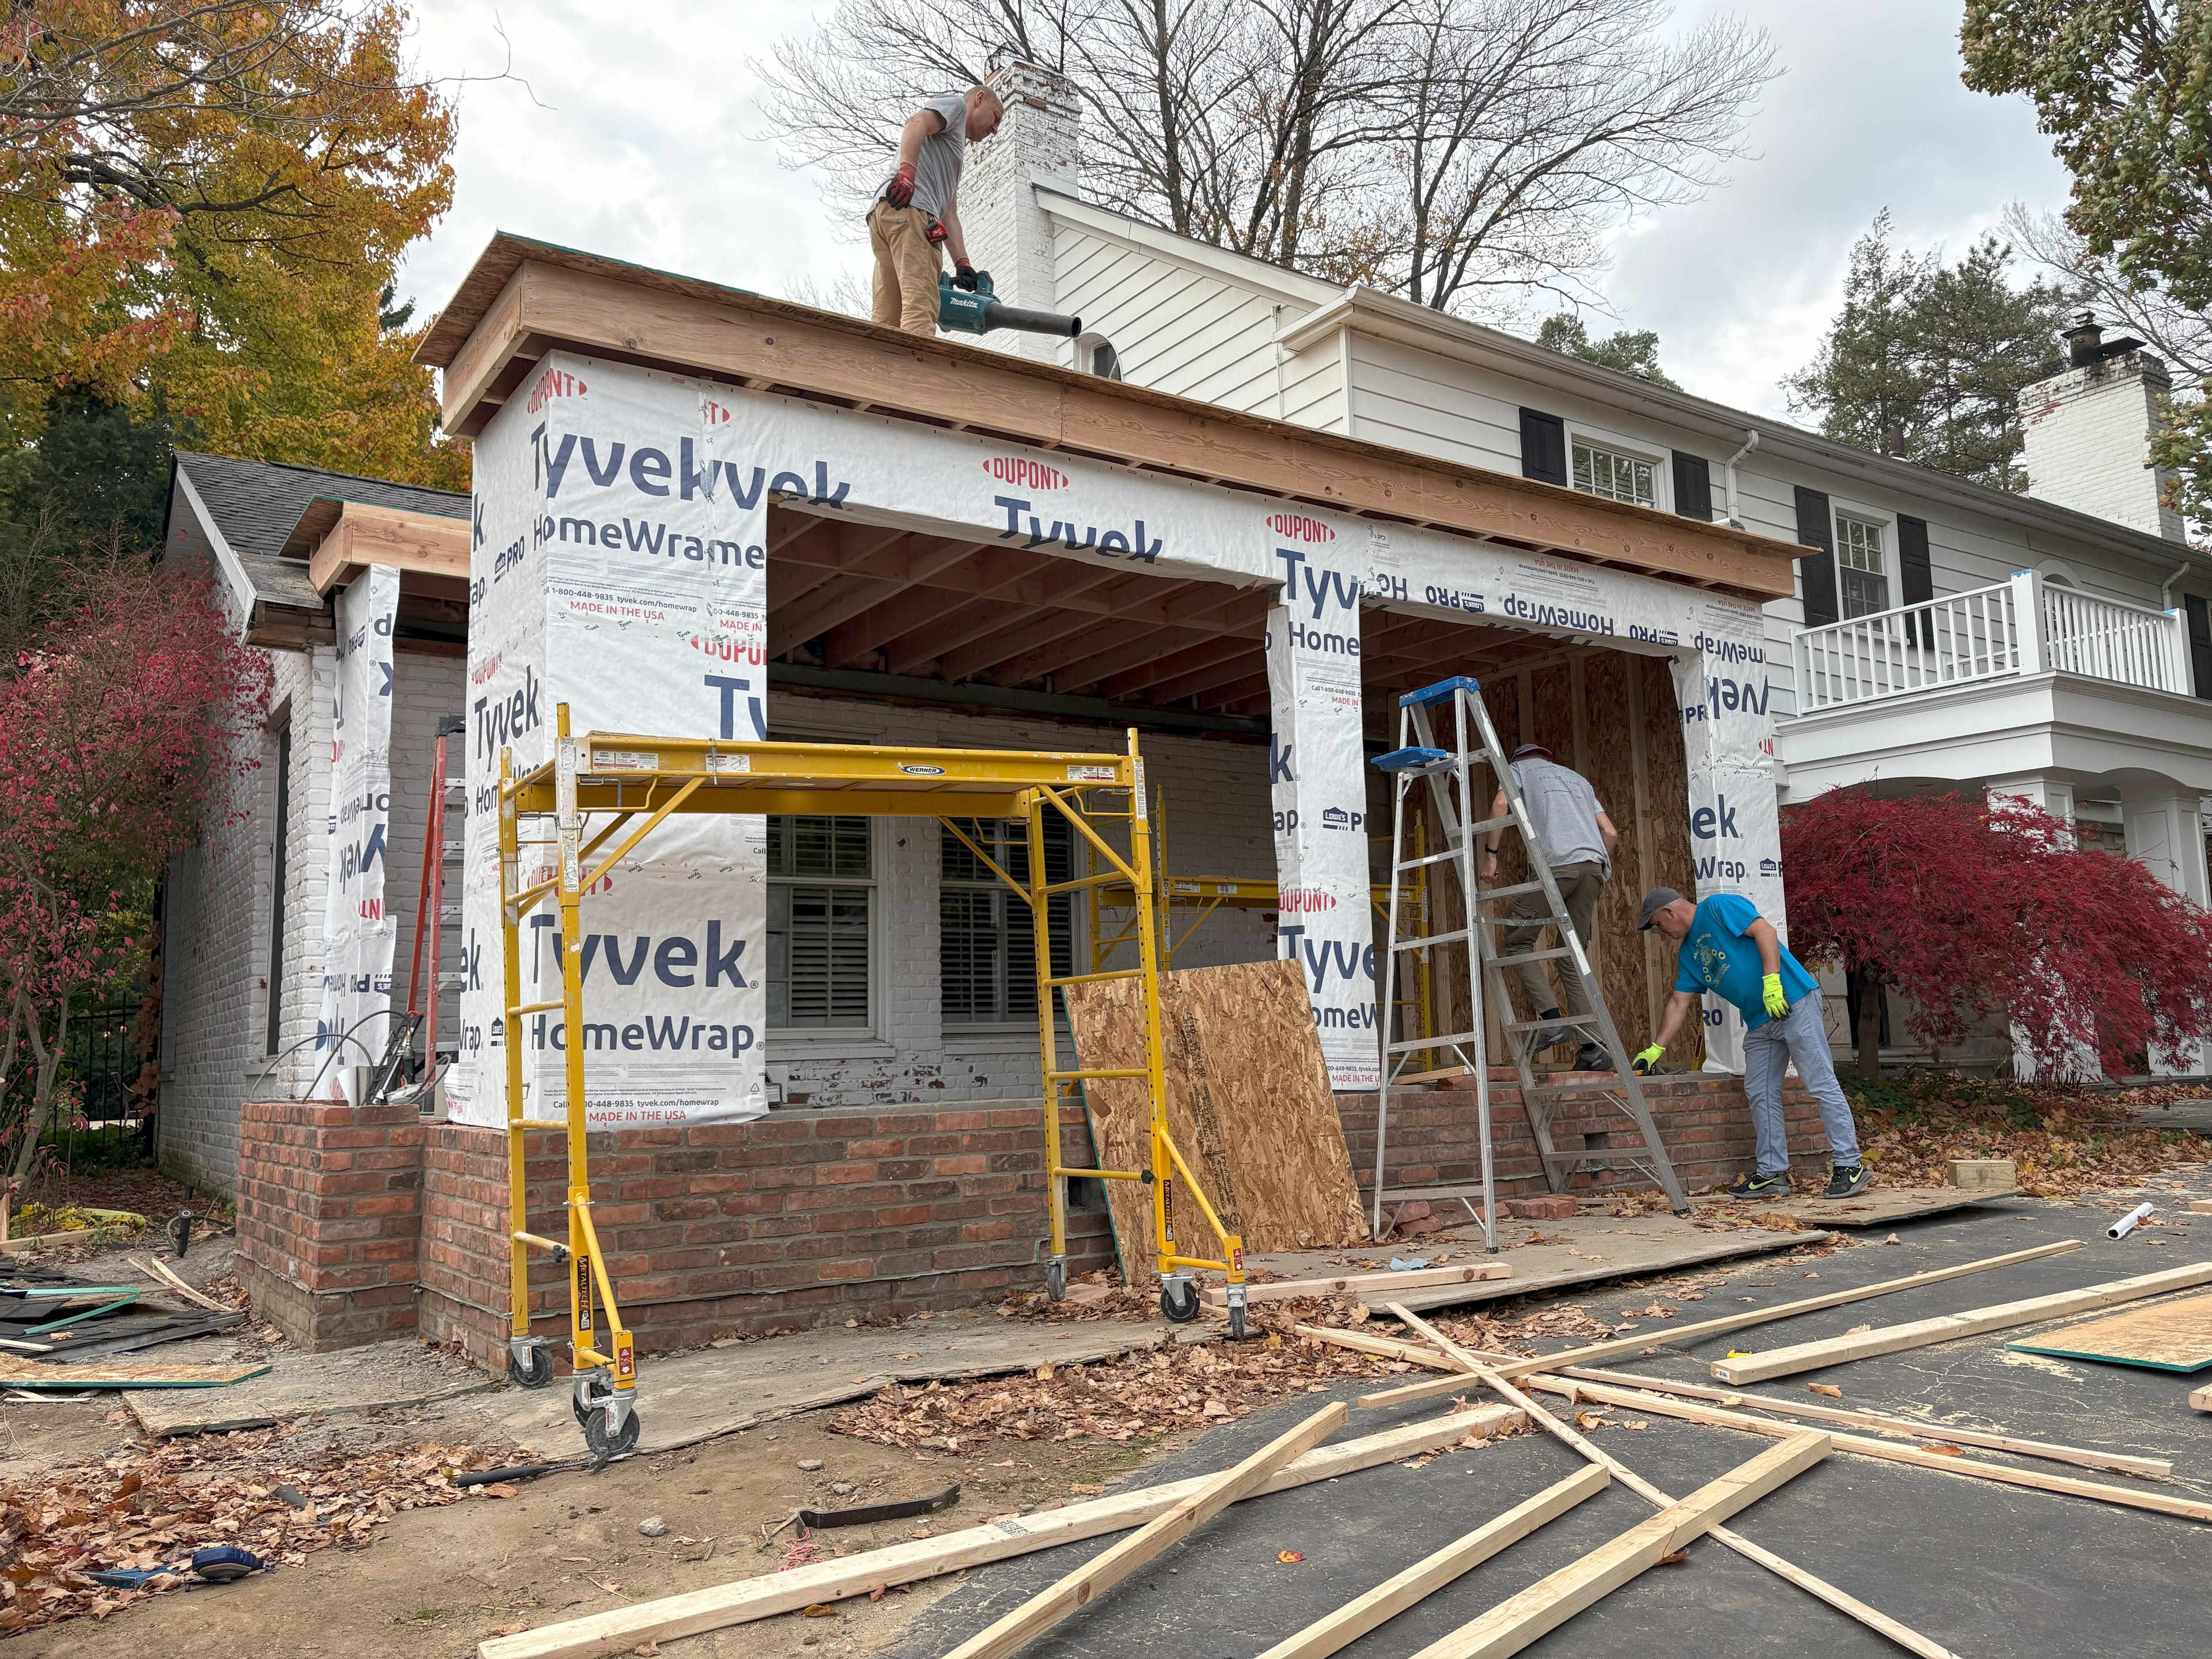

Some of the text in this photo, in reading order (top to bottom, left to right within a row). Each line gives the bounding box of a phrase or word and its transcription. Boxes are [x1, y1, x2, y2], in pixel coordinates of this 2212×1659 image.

[531, 369, 575, 414] DUPONT
[993, 457, 1059, 490] DUPONT
[994, 495, 1162, 564] Tyvek
[1275, 514, 1328, 543] DUPONT
[507, 535, 525, 573] PRO
[1534, 558, 1579, 573] MADE IN THE USA
[552, 588, 613, 601] 1-800-448-9835
[617, 596, 697, 614] tyvek.com/homewrap
[1426, 585, 1460, 608] PRO
[1718, 599, 1727, 607] USA
[1743, 604, 1755, 612] MADE
[570, 601, 665, 621] MADE IN THE USA
[1504, 593, 1613, 637] HomeWrap
[720, 619, 762, 632] MADE IN
[1630, 624, 1657, 643] PRO
[1289, 621, 1360, 657] Home
[1321, 686, 1356, 696] 1-800-448-9835
[1332, 696, 1350, 706] MADE
[475, 664, 539, 772] Tyvek
[1692, 794, 1739, 840] ek
[1694, 856, 1745, 883] Wrap
[1278, 888, 1330, 913] DUPONT
[531, 914, 748, 988] Tyvek
[350, 974, 370, 994] PRO
[532, 1014, 754, 1059] HomeWrap
[1332, 1074, 1351, 1082] MADE
[637, 1098, 719, 1108] tyvek.com/homewrap
[1188, 1091, 1197, 1112] DOWN
[589, 1110, 685, 1123] MADE IN THE USA
[1201, 1096, 1214, 1135] ROOF CLIPS
[1211, 1119, 1217, 1127] BE
[1197, 1129, 1205, 1144] THIS
[1214, 1175, 1227, 1210] STRENGTH
[1219, 1154, 1237, 1209] AXE PRINCIPALE
